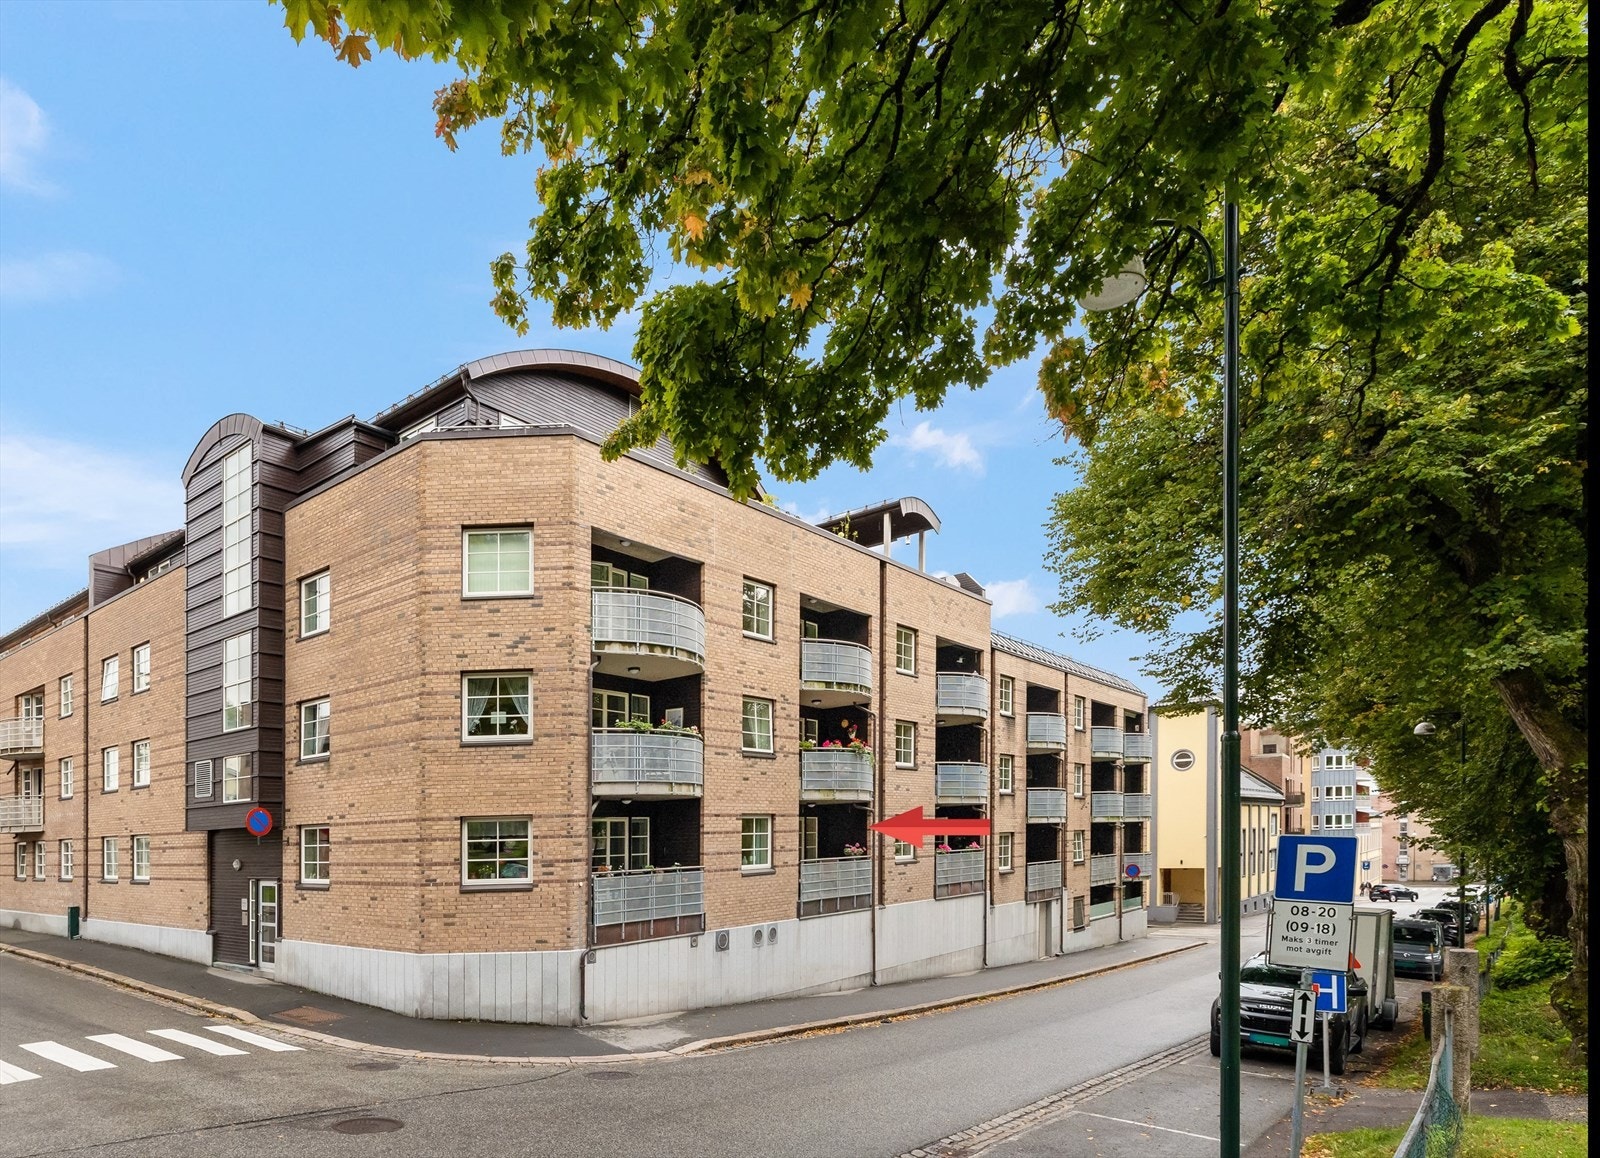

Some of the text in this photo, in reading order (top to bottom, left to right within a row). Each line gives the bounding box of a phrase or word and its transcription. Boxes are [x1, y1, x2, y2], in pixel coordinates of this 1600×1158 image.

[1293, 844, 1337, 892] P
[1290, 905, 1336, 918] 08-20
[1286, 920, 1336, 936] (09-18)
[1281, 935, 1304, 943] Maks
[1315, 938, 1339, 946] timer
[1286, 945, 1332, 955] mot avgift
